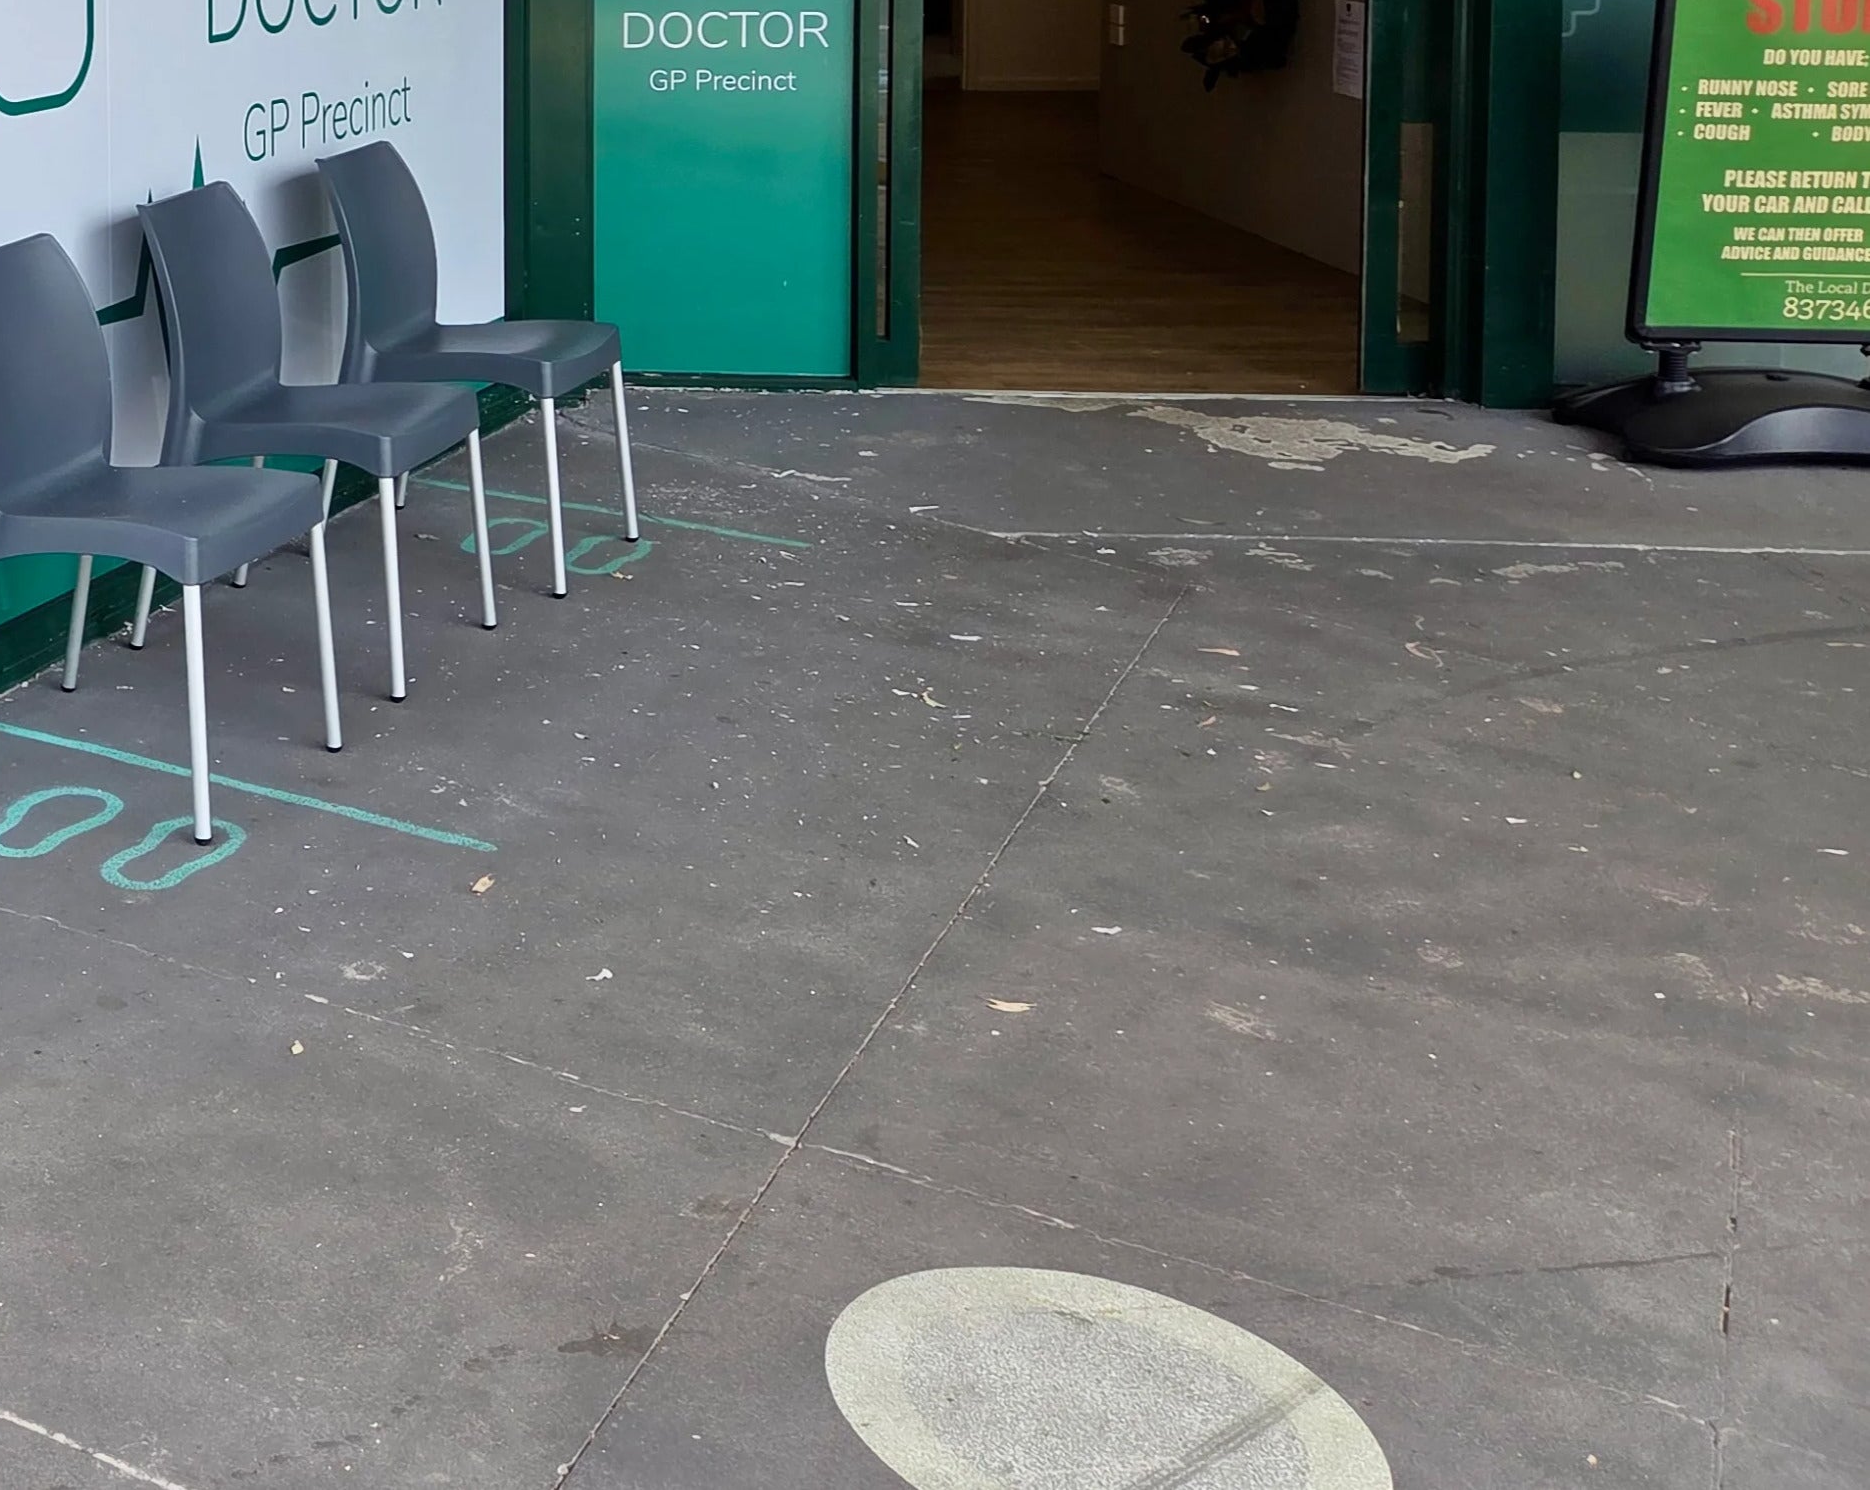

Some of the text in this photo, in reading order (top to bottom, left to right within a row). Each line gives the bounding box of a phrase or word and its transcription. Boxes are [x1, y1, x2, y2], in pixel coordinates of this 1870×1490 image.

[623, 11, 829, 49] DOCTOR
[1763, 49, 1786, 65] DO
[1790, 49, 1821, 66] YOU
[649, 69, 797, 91] GP Precinct
[1698, 79, 1868, 97] RUNNY NOSE SORE
[244, 76, 411, 161] GP Precinct
[1695, 101, 1743, 118] FEVER
[1771, 103, 1837, 119] ASTHMA
[1693, 124, 1751, 140] COUGH
[1724, 170, 1787, 188] PLEASE
[1790, 171, 1857, 188] RETURN
[1702, 194, 1750, 212] YOUR
[1754, 195, 1790, 213] CAR
[1792, 196, 1828, 214] AND
[1734, 227, 1864, 242] WE CAN THEN OFFER
[1721, 246, 1870, 262] ADVICE AND GUIDANCE
[1785, 280, 1814, 293] The
[1818, 281, 1857, 294] Local
